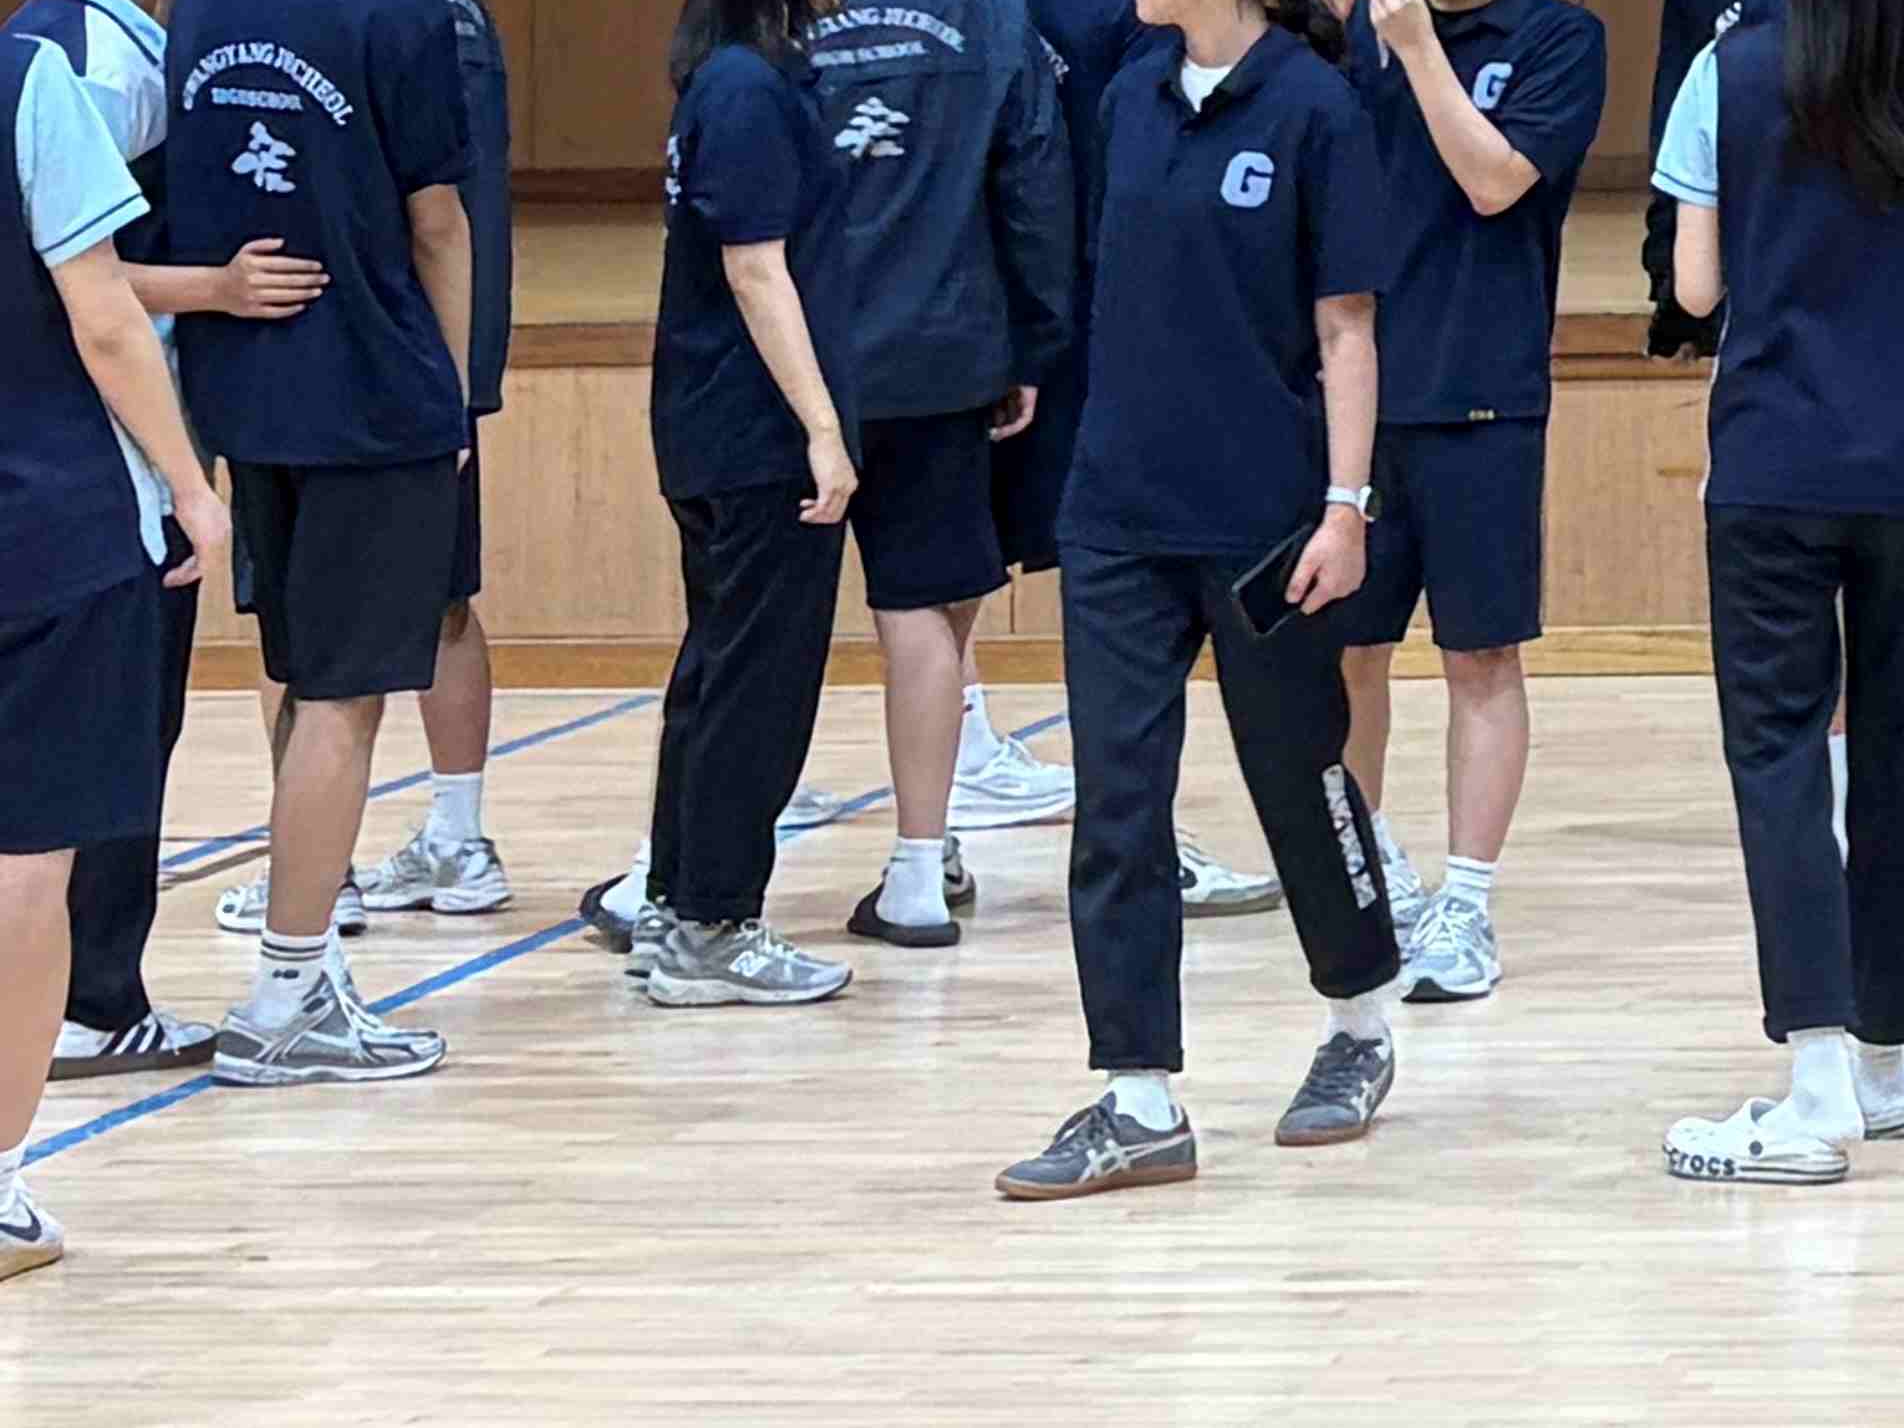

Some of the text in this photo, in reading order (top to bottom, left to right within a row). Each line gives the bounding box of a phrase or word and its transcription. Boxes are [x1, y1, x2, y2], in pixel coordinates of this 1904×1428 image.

[1472, 61, 1512, 110] G
[1220, 150, 1275, 208] G
[1668, 1148, 1737, 1177] crocs
